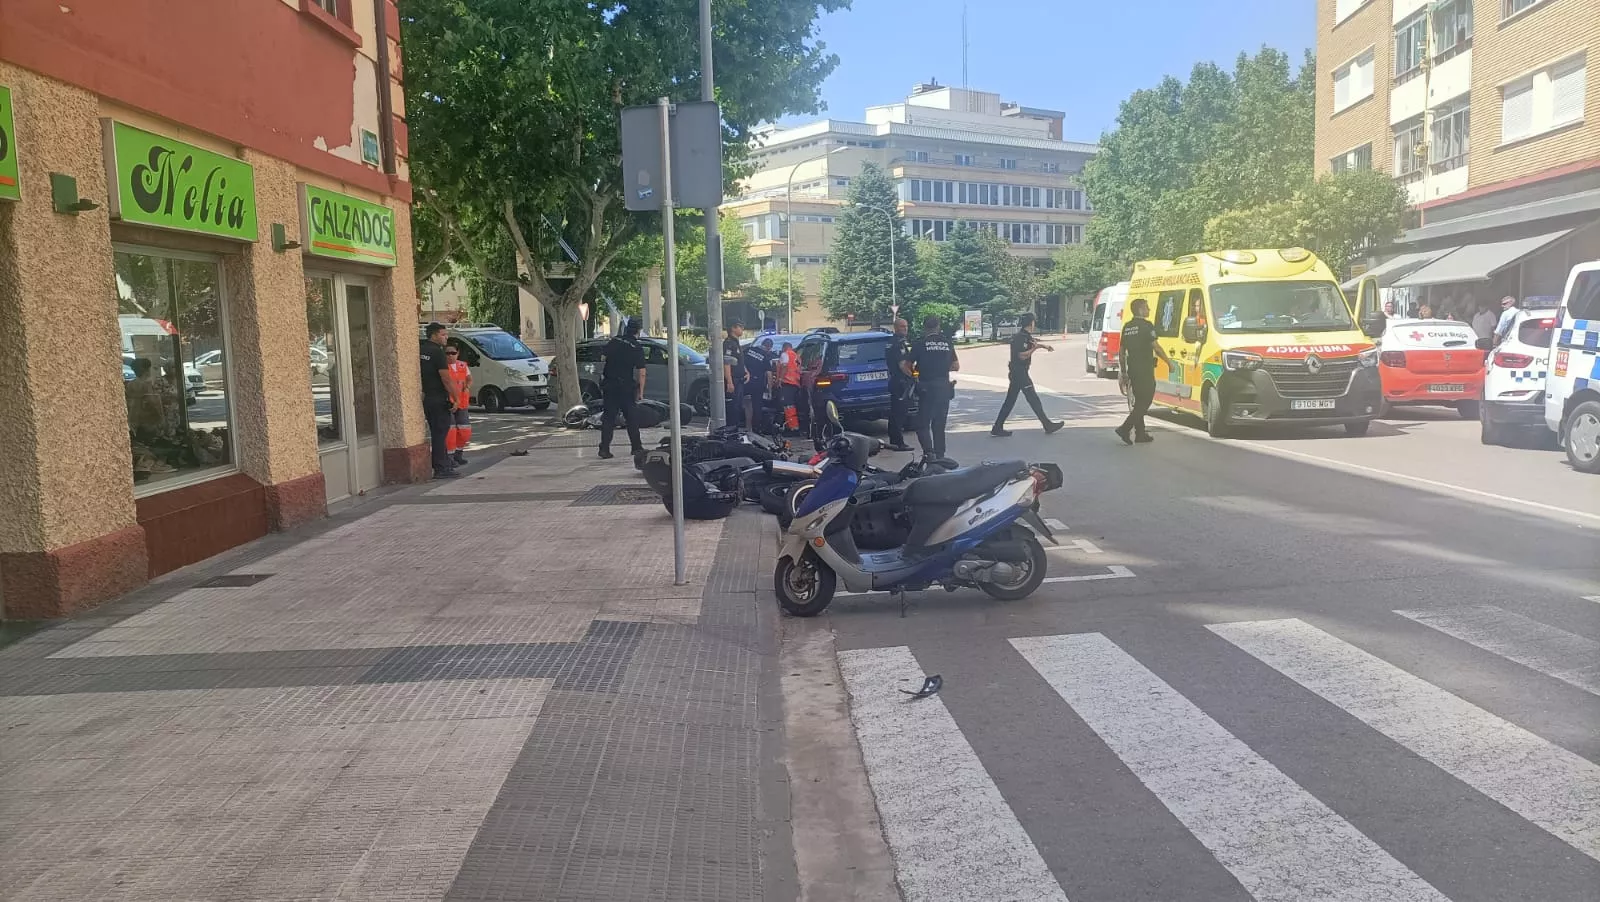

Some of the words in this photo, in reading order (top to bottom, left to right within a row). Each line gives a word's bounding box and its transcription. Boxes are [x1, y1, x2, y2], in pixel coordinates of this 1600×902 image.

[131, 146, 247, 229] Nelia
[311, 197, 391, 248] CALZADOS
[1449, 331, 1468, 339] Roja
